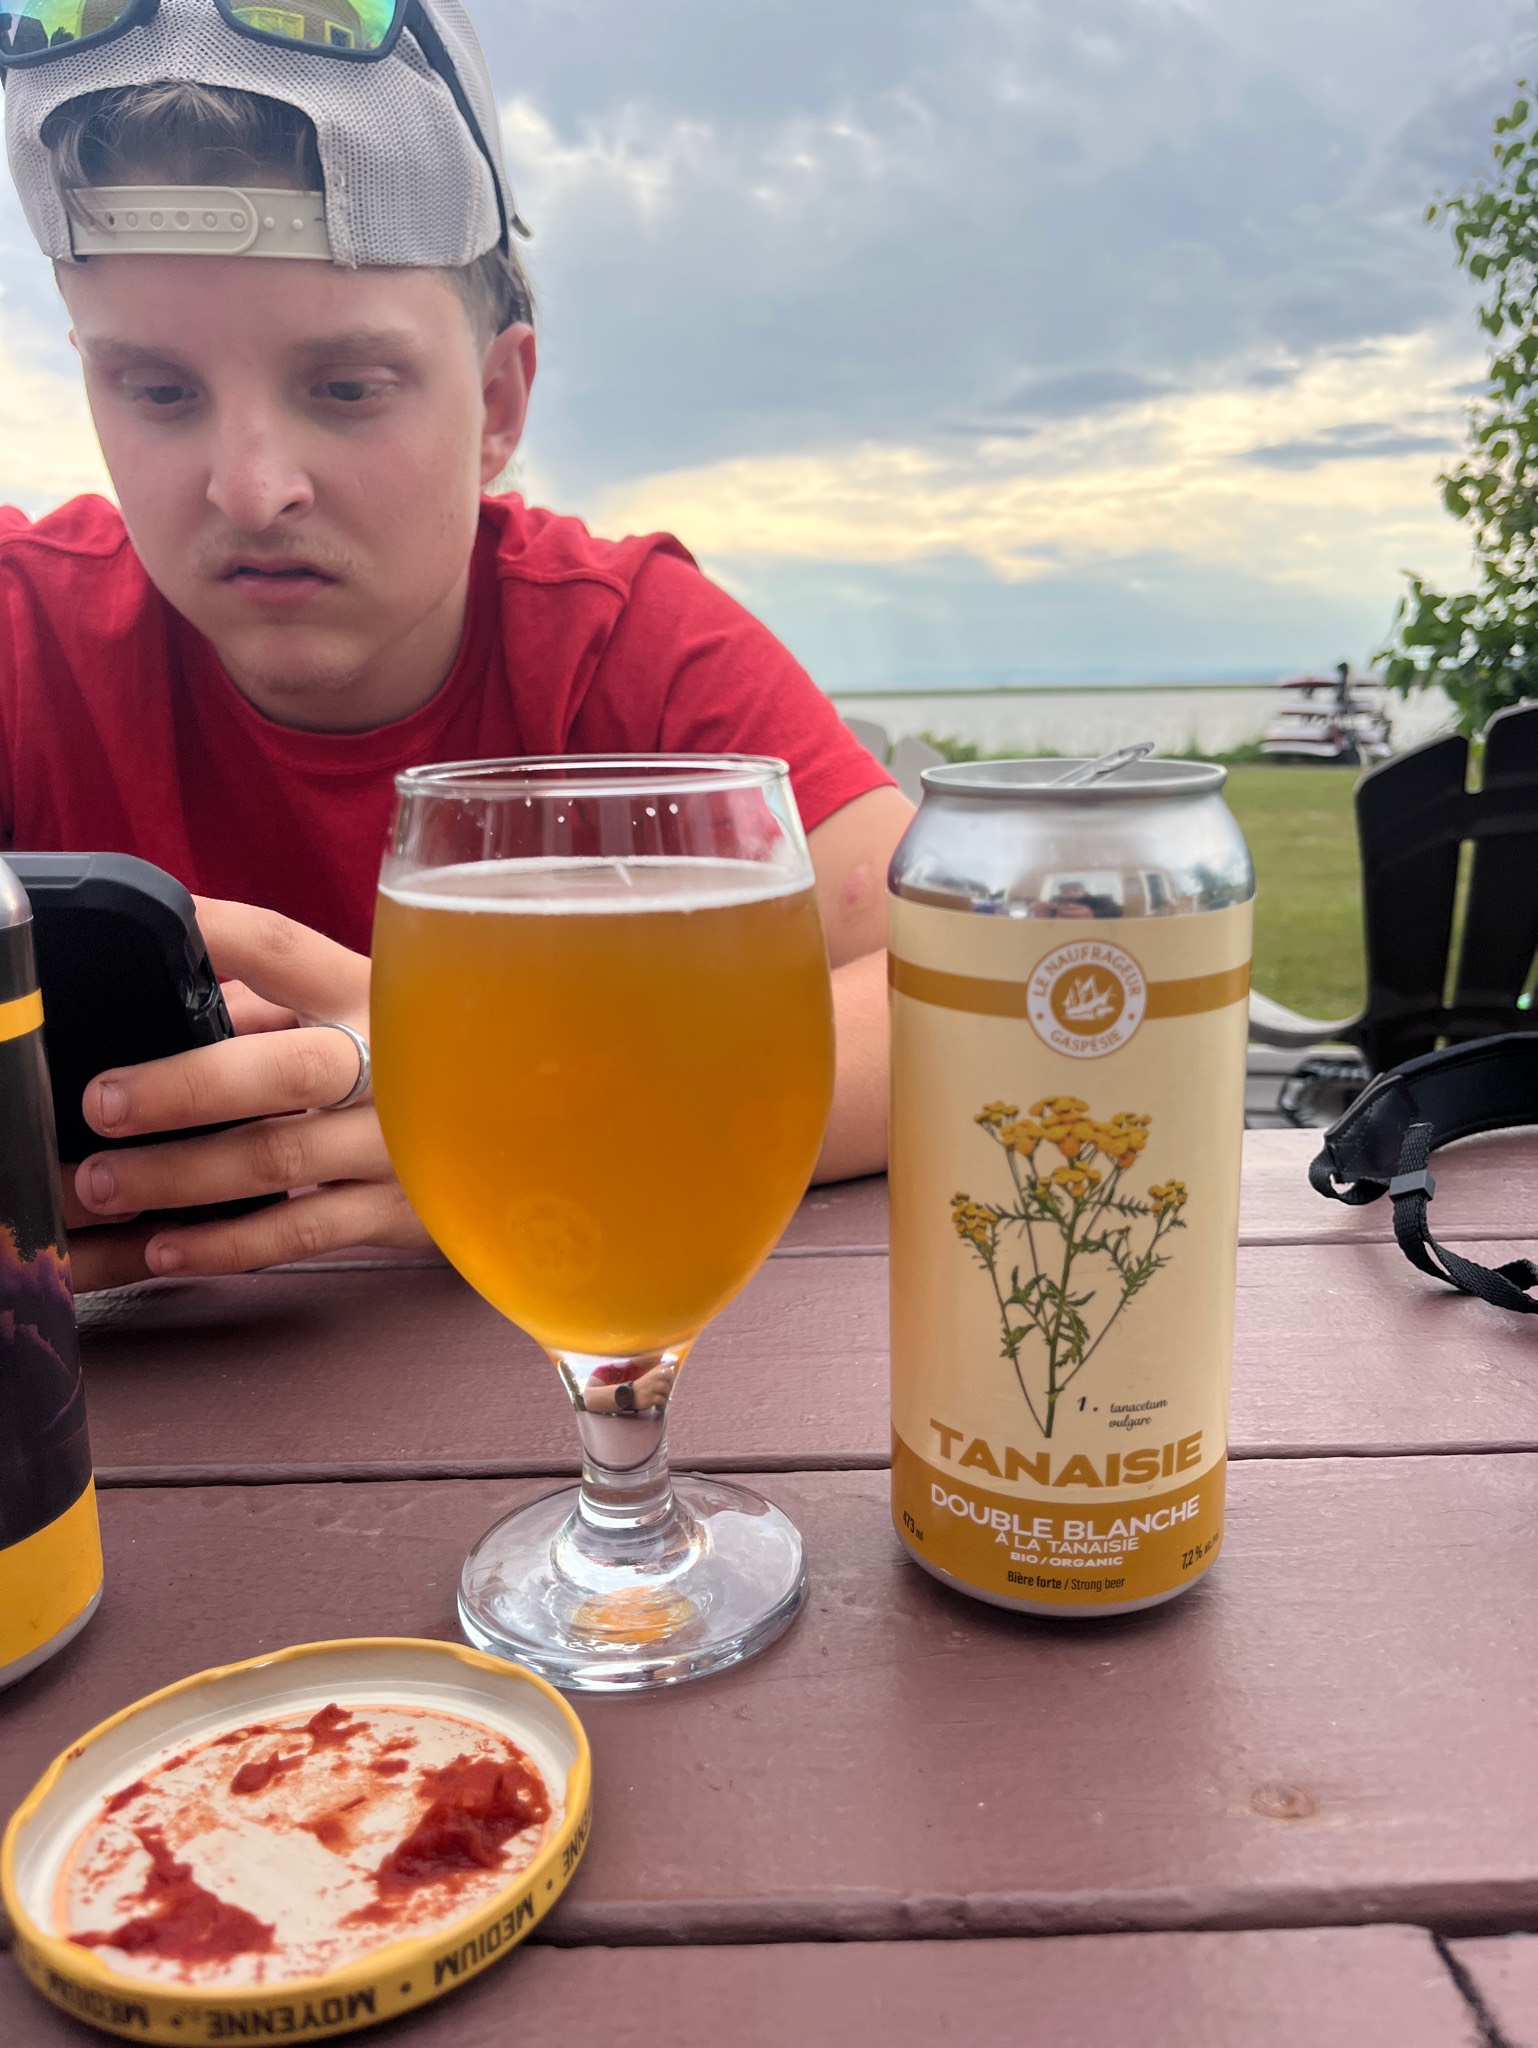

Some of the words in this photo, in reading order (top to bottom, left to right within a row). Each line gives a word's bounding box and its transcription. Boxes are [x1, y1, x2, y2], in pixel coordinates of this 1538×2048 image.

[1031, 976, 1050, 998] LE
[1044, 946, 1142, 998] NAUFRAGEUR
[1050, 1029, 1123, 1052] GASPÉSIE
[1110, 1399, 1168, 1413] tanacetum
[1109, 1414, 1152, 1431] vulgare
[929, 1417, 1203, 1488] TANAISIE
[903, 1510, 915, 1534] 473
[930, 1483, 1054, 1539] DOUBLE
[1063, 1494, 1201, 1541] BLANCHE
[1014, 1535, 1041, 1551] LA
[1046, 1537, 1140, 1555] TANAISIE
[1010, 1551, 1039, 1564] BIO
[1049, 1556, 1124, 1568] ORGANIC
[1007, 1570, 1034, 1587] Bière
[1036, 1575, 1062, 1590] forte
[1063, 1578, 1069, 1591] /
[1071, 1578, 1103, 1593] Strong
[1105, 1577, 1126, 1589] beer
[434, 1893, 534, 1986] MEDIUM
[206, 1987, 376, 2040] MOYENNE
